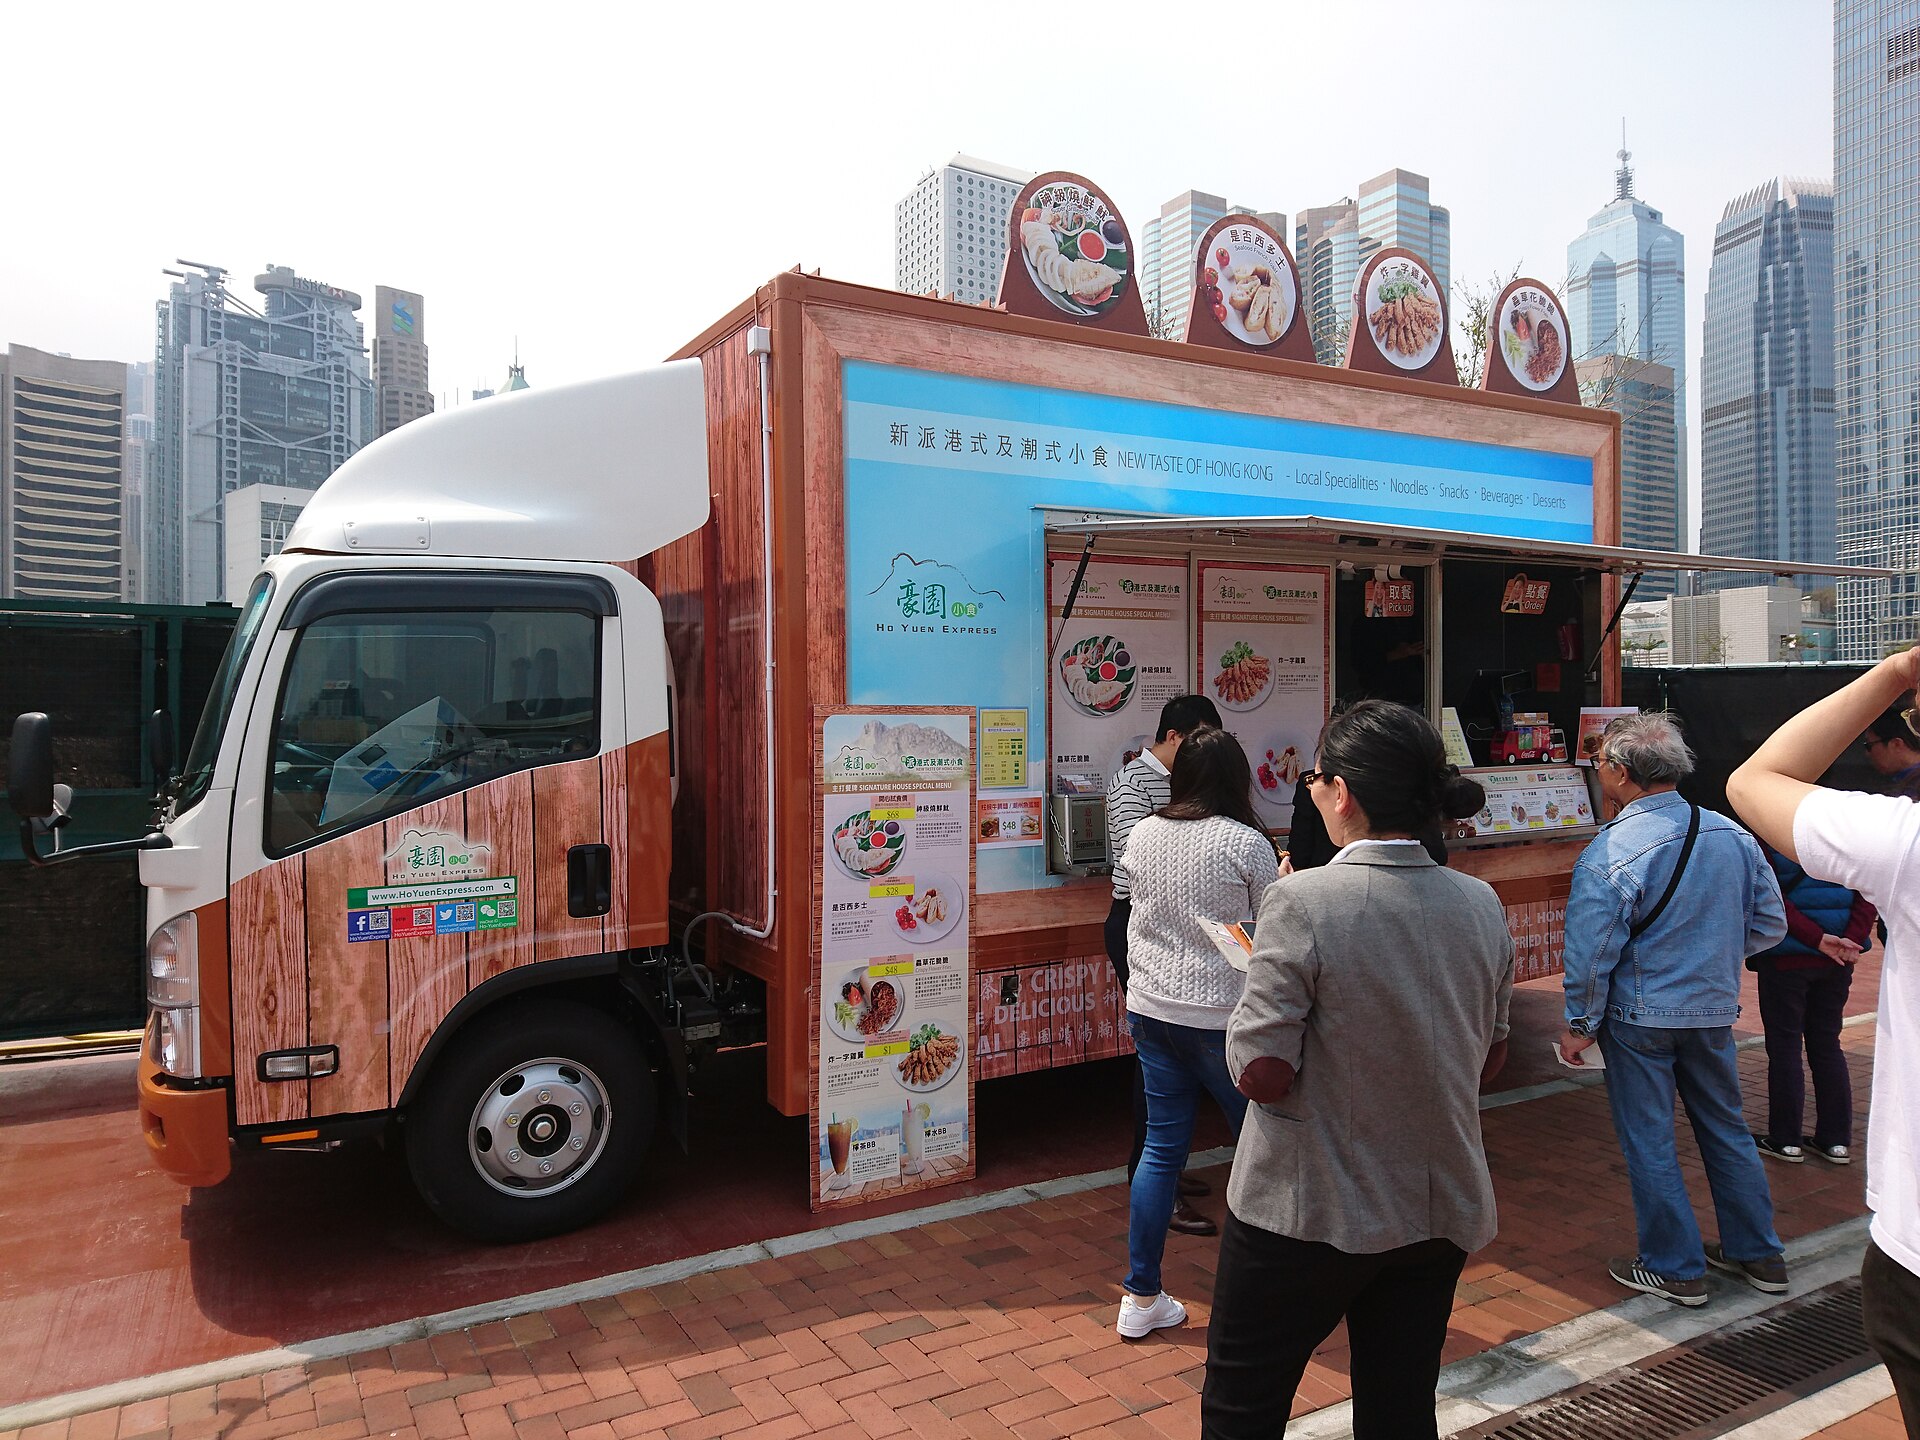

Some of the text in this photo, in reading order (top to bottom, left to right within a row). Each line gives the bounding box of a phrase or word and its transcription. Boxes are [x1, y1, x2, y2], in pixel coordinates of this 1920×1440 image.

[1230, 229, 1286, 270] 是否西多士
[293, 277, 328, 294] HSBC
[889, 421, 1567, 510] 新派港式及潮式小食 NEW TASTE OF HONG KONG Local Specialities Noodles Snacks Beverages Desserts
[1389, 585, 1412, 600] 取餐
[1524, 585, 1548, 600] 點餐
[1388, 602, 1412, 613] Pick up
[1524, 601, 1544, 611] Order
[1084, 609, 1114, 617] SIGNATURE
[1133, 610, 1154, 618] SPECIAL
[1155, 611, 1171, 619] MENU
[1276, 615, 1294, 623] SPECIAL
[859, 783, 892, 792] SIGNATURE
[912, 782, 935, 790] SPECIAL
[1002, 821, 1017, 831] $48
[372, 884, 494, 901] www.HoYuenExpress.com
[885, 886, 899, 896] $28
[832, 901, 868, 912] 是否西多士
[885, 965, 898, 975] $48
[1031, 961, 1101, 993] CRISPY
[994, 991, 1096, 1026] DELICIOUS
[883, 1045, 891, 1056] $1
